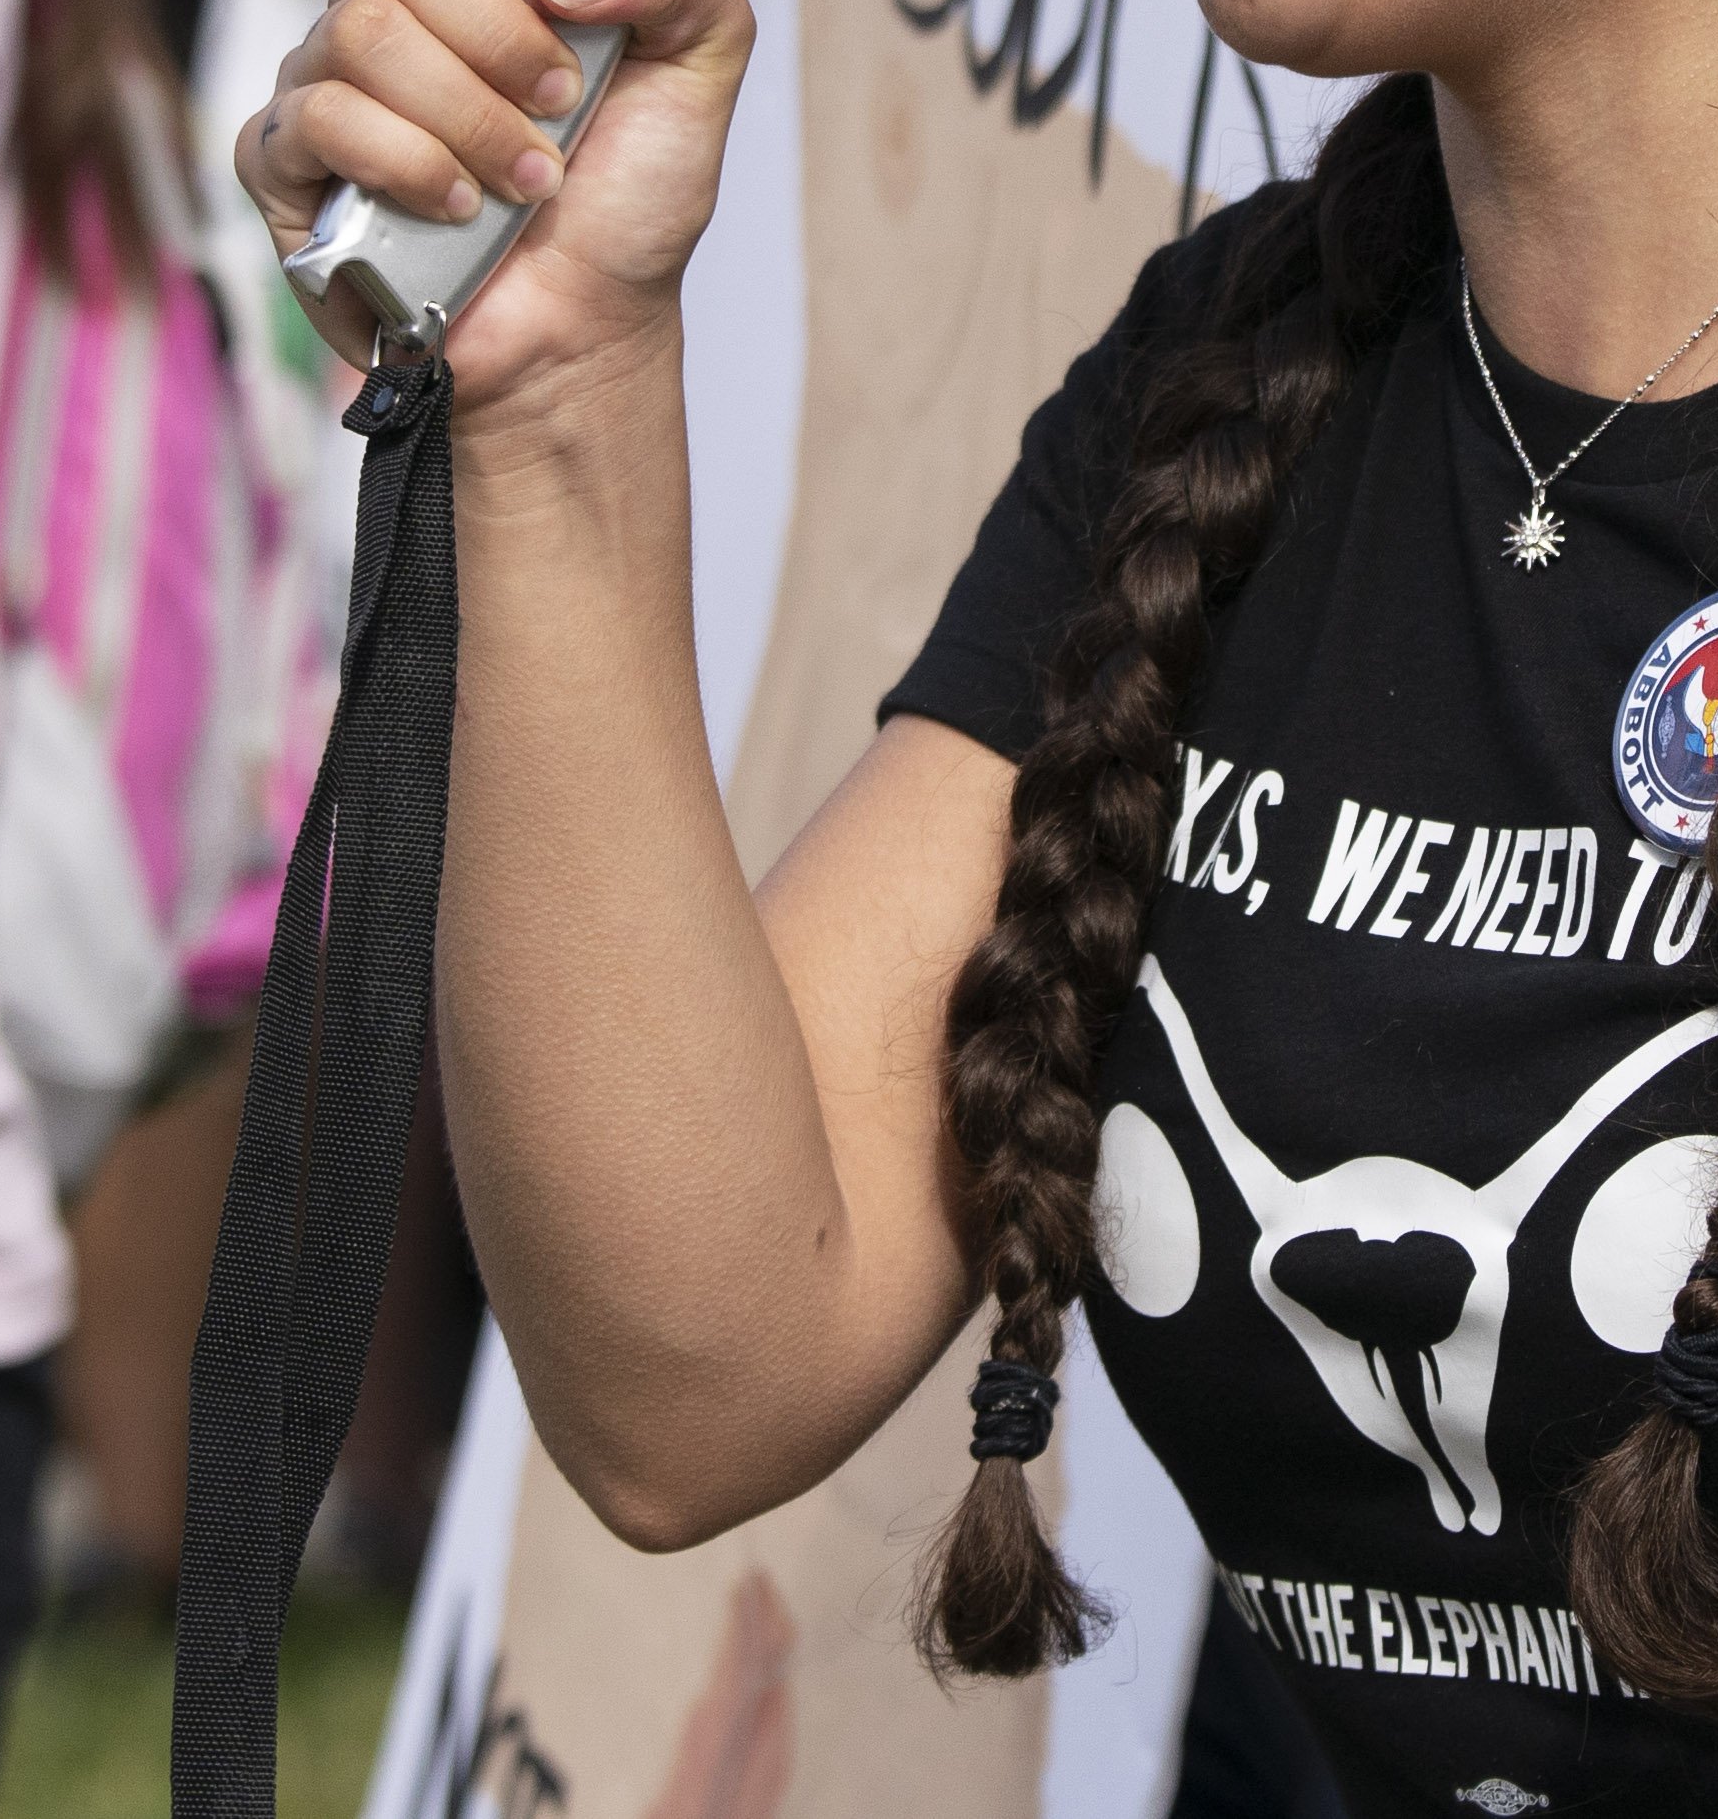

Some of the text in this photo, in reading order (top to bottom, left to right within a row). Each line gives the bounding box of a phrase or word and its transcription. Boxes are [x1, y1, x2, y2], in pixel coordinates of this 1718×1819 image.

[1621, 642, 1672, 813] ABBOTT
[1307, 799, 1455, 938] WE
[1425, 826, 1597, 958] NEED
[1606, 838, 1714, 966] TO
[1271, 1577, 1363, 1670] THE
[1365, 1588, 1600, 1696] ELEPHANT
